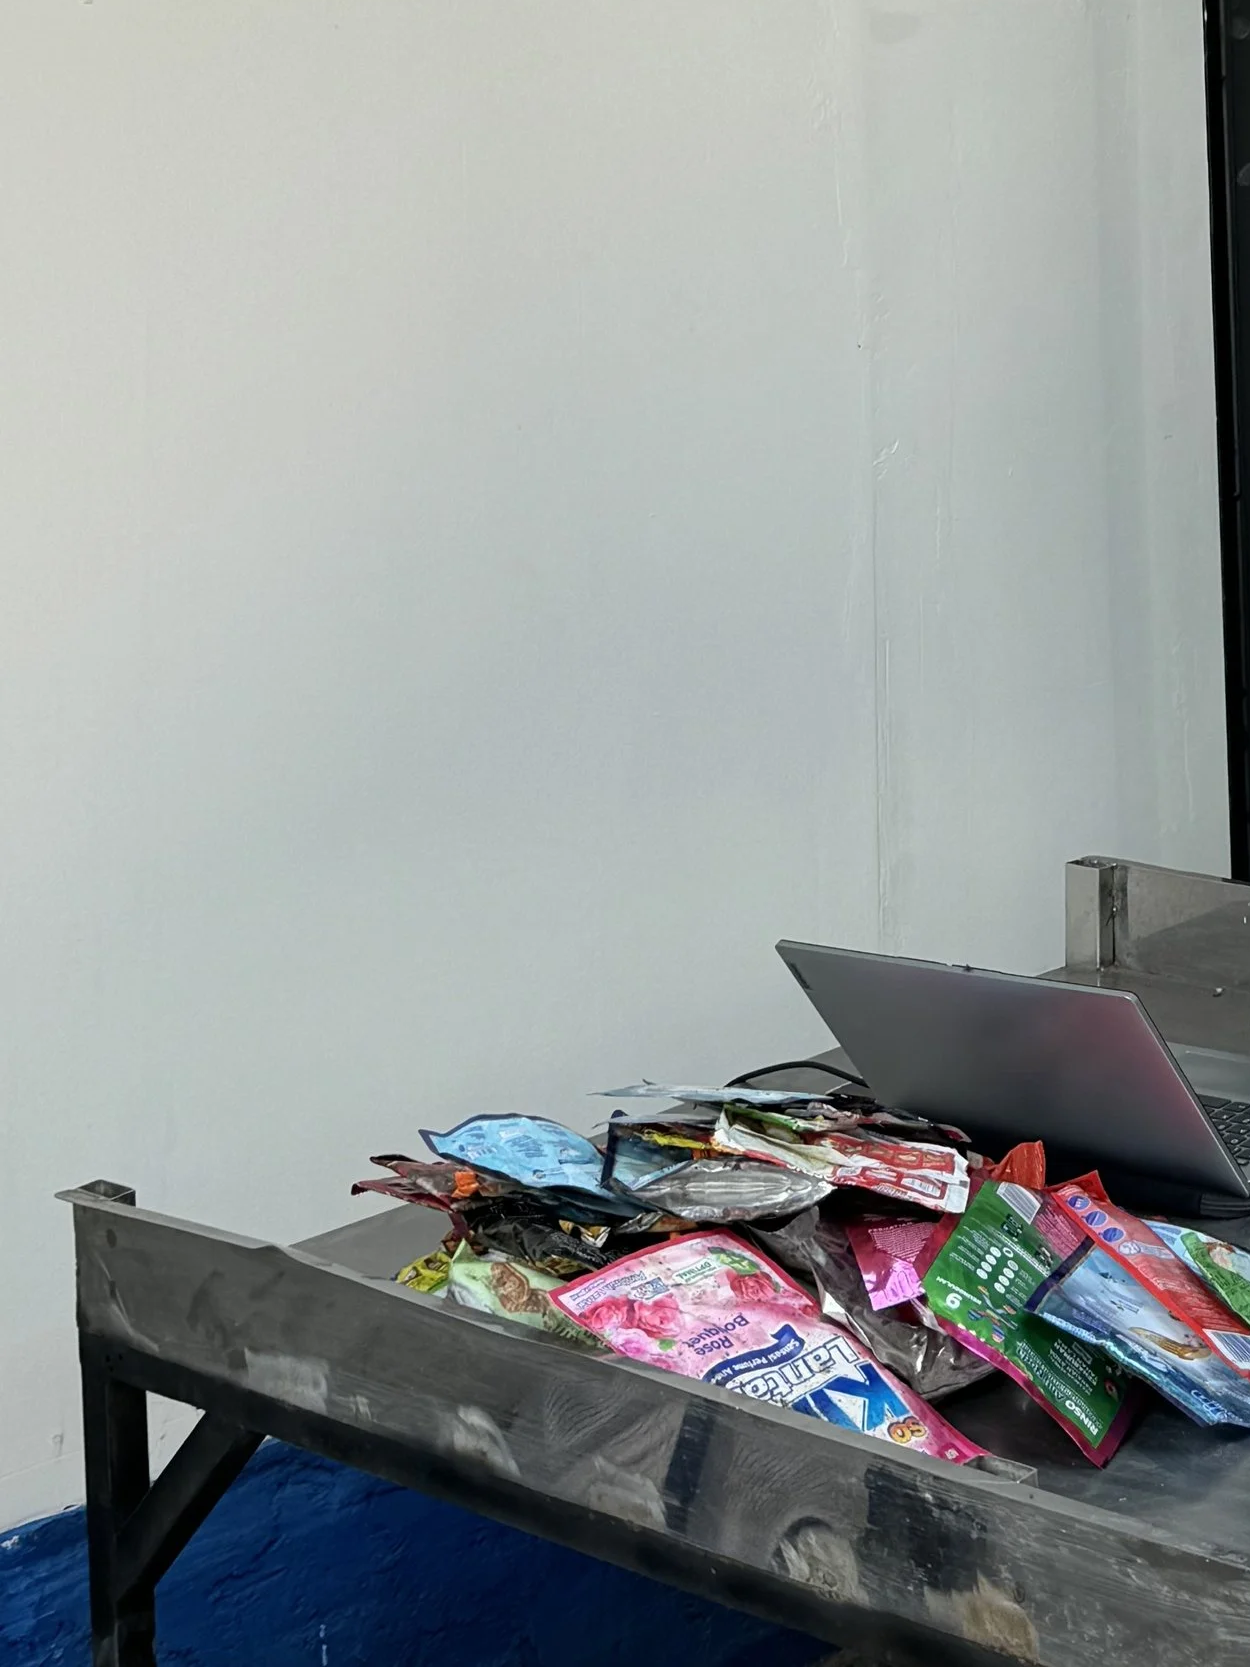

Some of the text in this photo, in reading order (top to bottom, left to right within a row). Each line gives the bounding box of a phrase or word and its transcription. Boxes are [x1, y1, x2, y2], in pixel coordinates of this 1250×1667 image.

[680, 1312, 750, 1351] Bouquet
[693, 1335, 734, 1358] Rose
[884, 1416, 929, 1447] SO
[1063, 1398, 1100, 1436] RINSO
